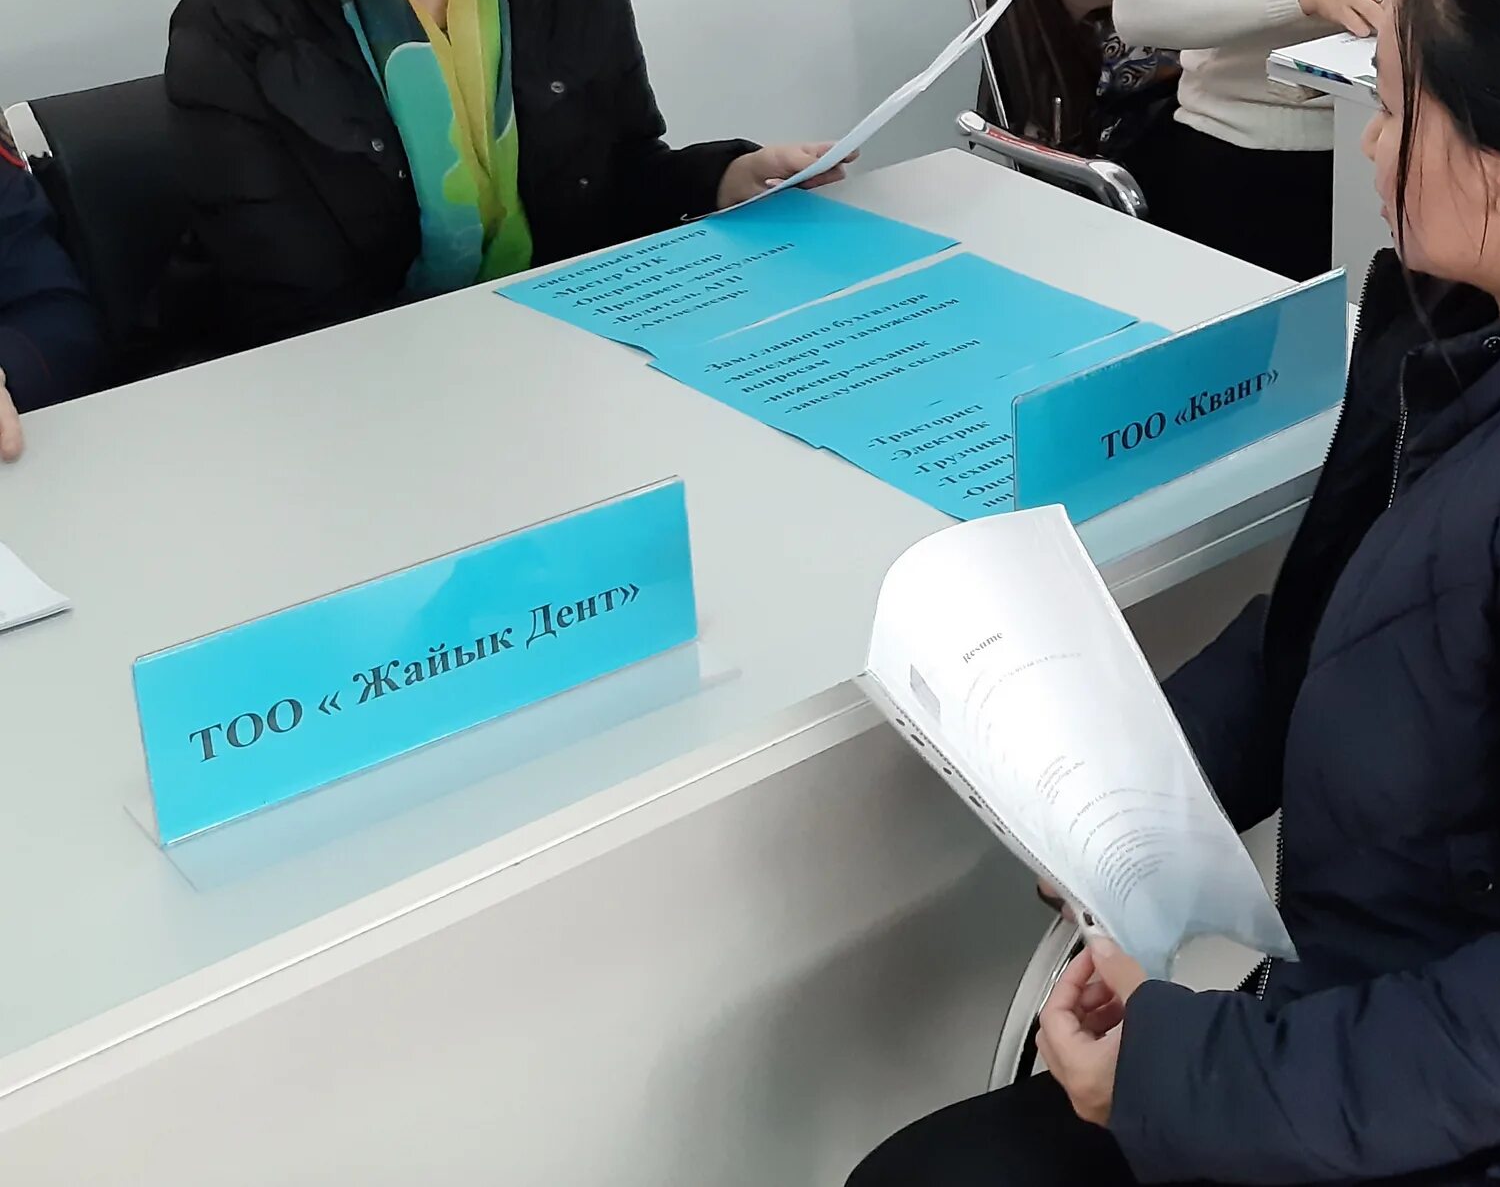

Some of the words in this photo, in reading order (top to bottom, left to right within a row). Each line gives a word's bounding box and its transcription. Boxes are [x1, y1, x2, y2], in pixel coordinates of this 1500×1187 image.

[636, 229, 707, 255] инженер
[625, 255, 668, 274] ОТК
[665, 253, 722, 275] кассир
[822, 339, 845, 349] по
[847, 298, 959, 340] таможенным
[832, 293, 928, 328] бухгалтера
[908, 339, 981, 368] складом
[741, 359, 831, 393] вопросам
[1101, 411, 1166, 460] ТОО
[1174, 368, 1279, 427] «Квант»
[962, 632, 1003, 664] Resume
[189, 698, 303, 763] ТОО
[353, 627, 515, 705] Жайык
[525, 583, 641, 649] Дент»
